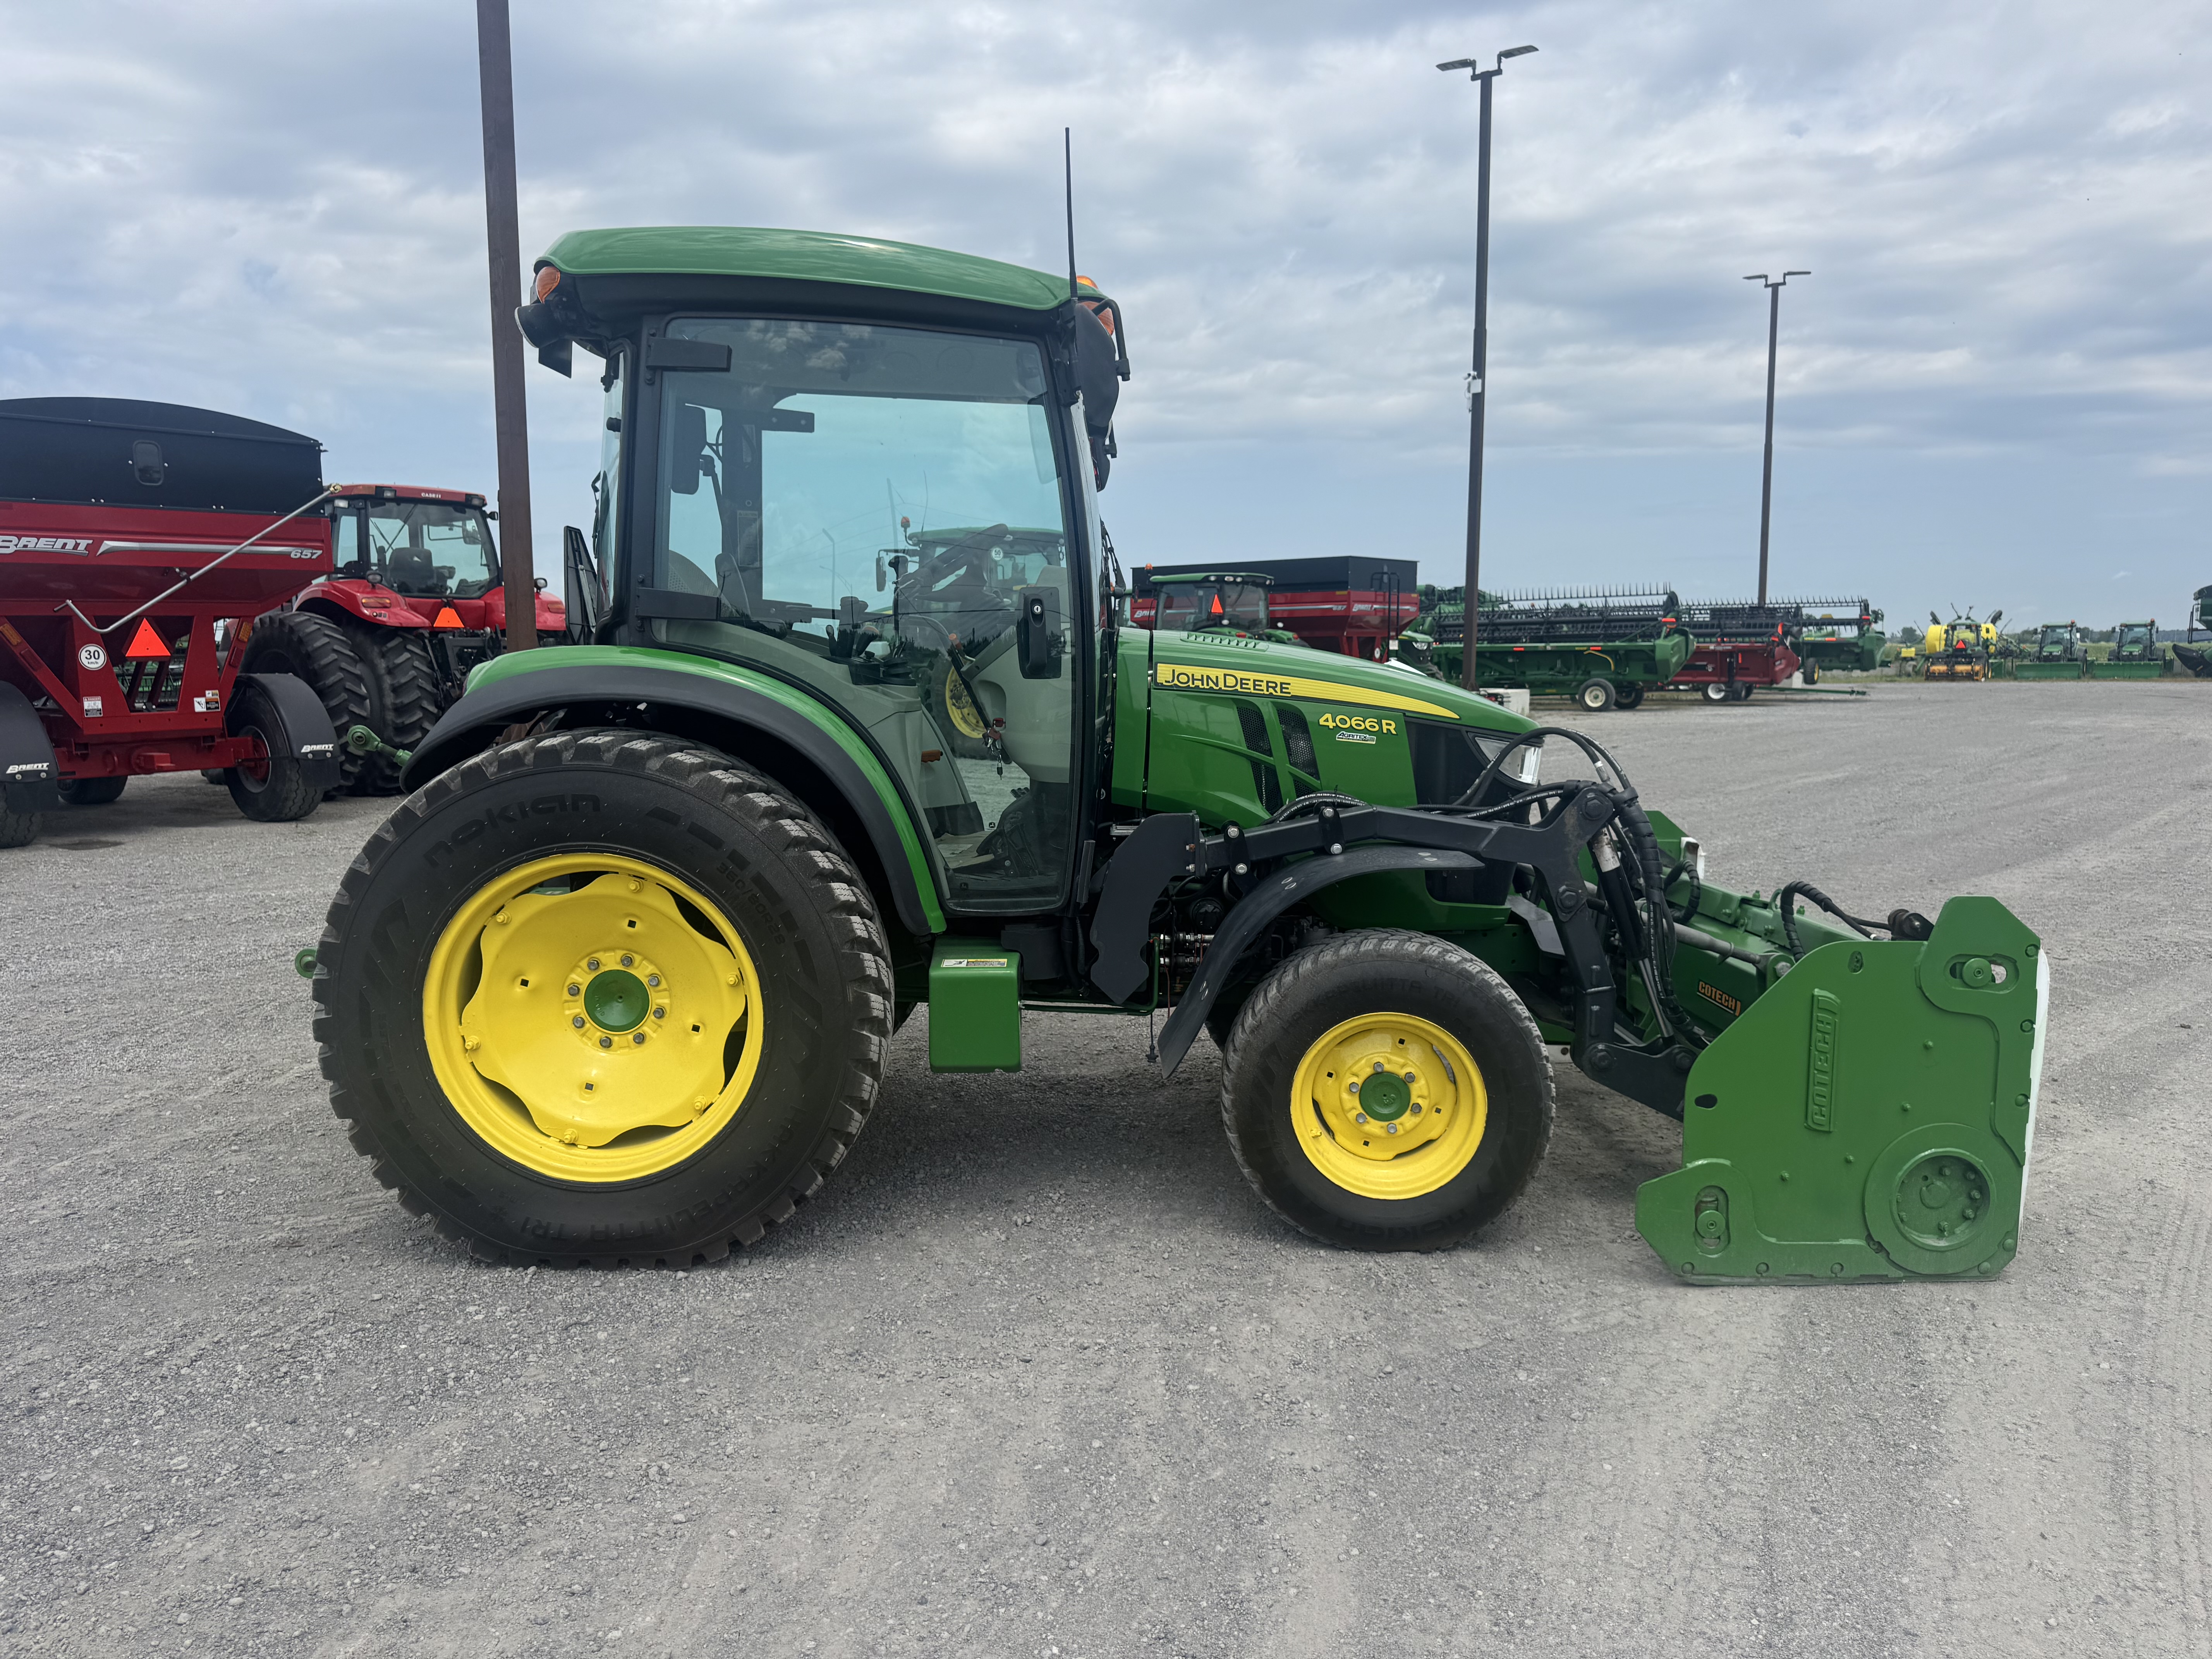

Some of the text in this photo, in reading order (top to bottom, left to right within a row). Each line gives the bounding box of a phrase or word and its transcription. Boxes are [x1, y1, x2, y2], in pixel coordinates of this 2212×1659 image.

[0, 536, 93, 554] BRENT
[291, 550, 323, 559] 657
[85, 650, 100, 660] 30
[1164, 669, 1291, 695] JOHN DEERE
[301, 744, 334, 753] BRENT
[6, 763, 50, 774] BRENT
[1698, 981, 1736, 1010] COTECH
[1812, 1013, 1832, 1126] COTECH
